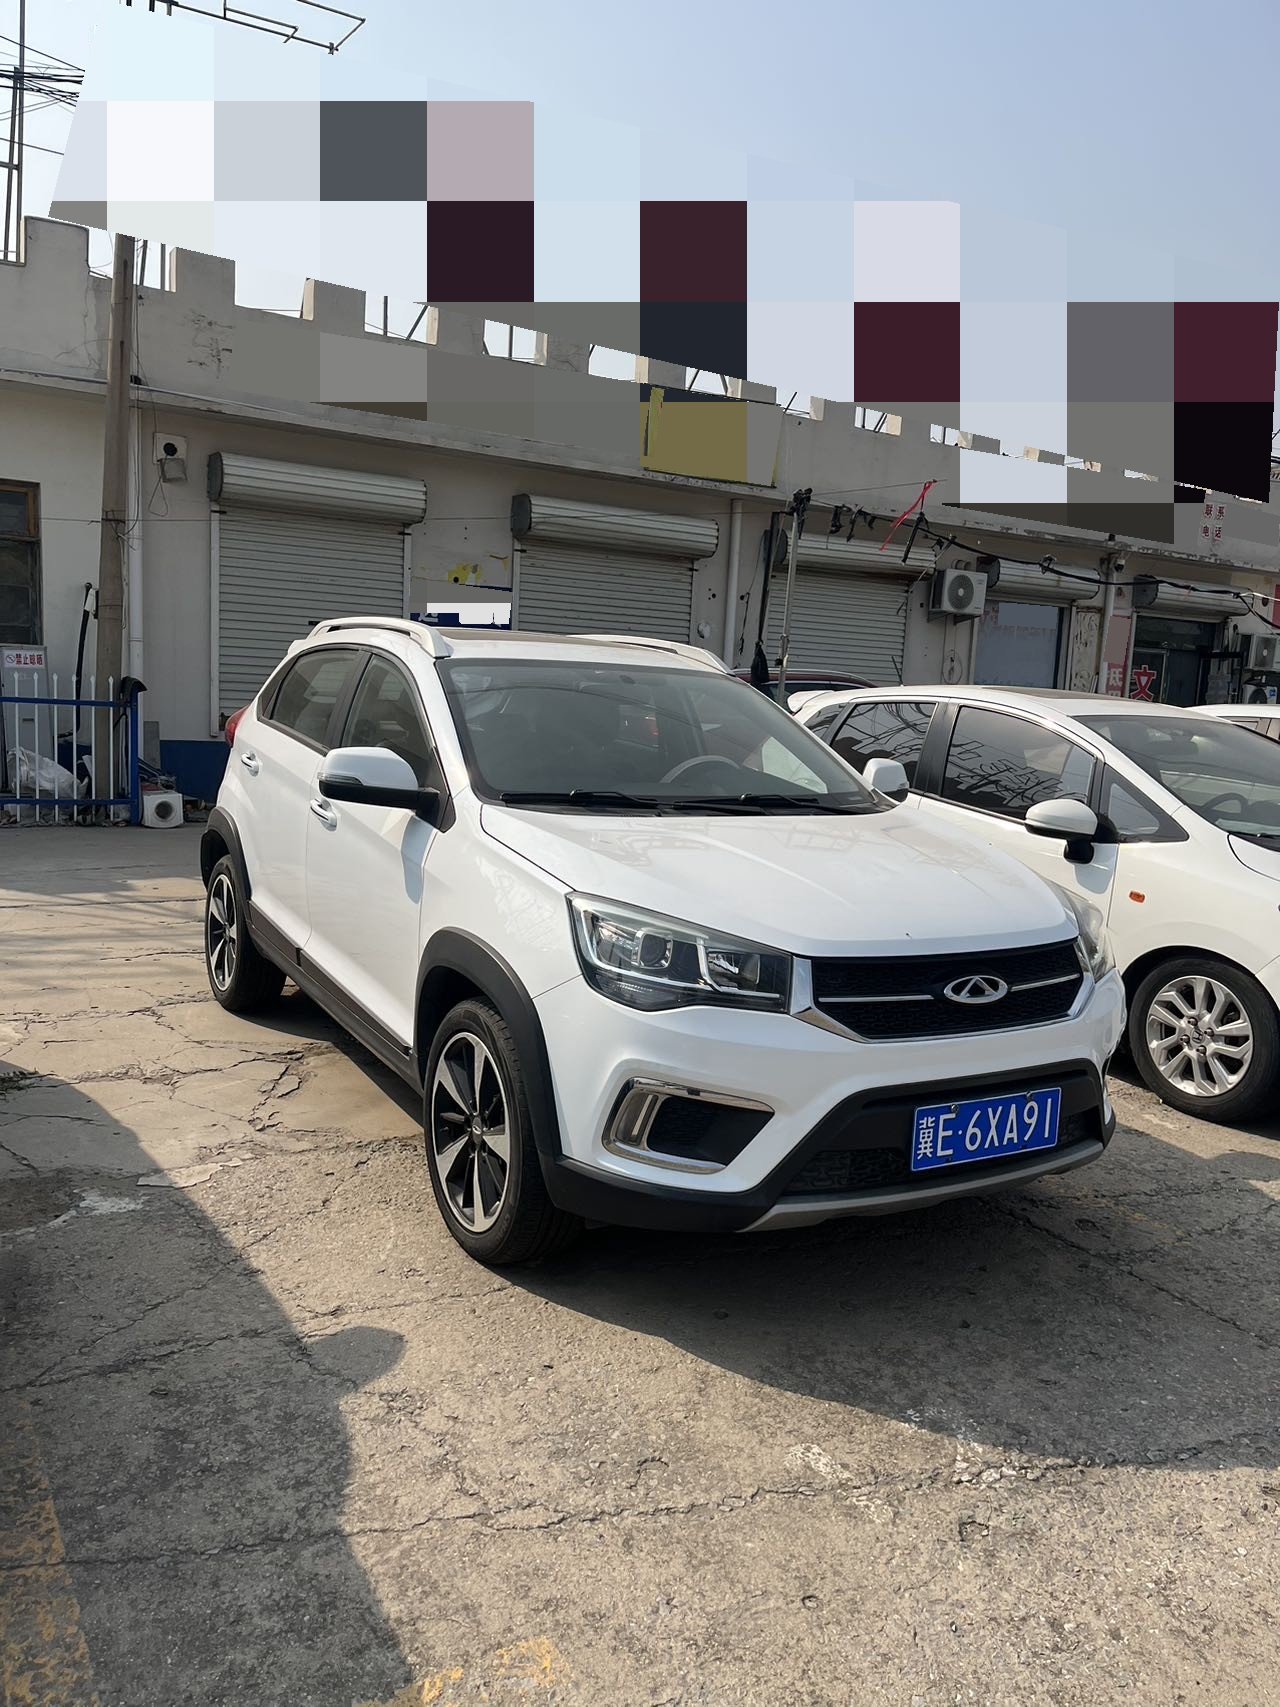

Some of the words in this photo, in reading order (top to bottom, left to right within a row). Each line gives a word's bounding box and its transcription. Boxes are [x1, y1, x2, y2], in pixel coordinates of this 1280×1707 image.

[15, 652, 43, 666] 禁止晾晒
[1130, 664, 1158, 702] 文
[916, 1097, 1052, 1160] 冀E·6XA91
